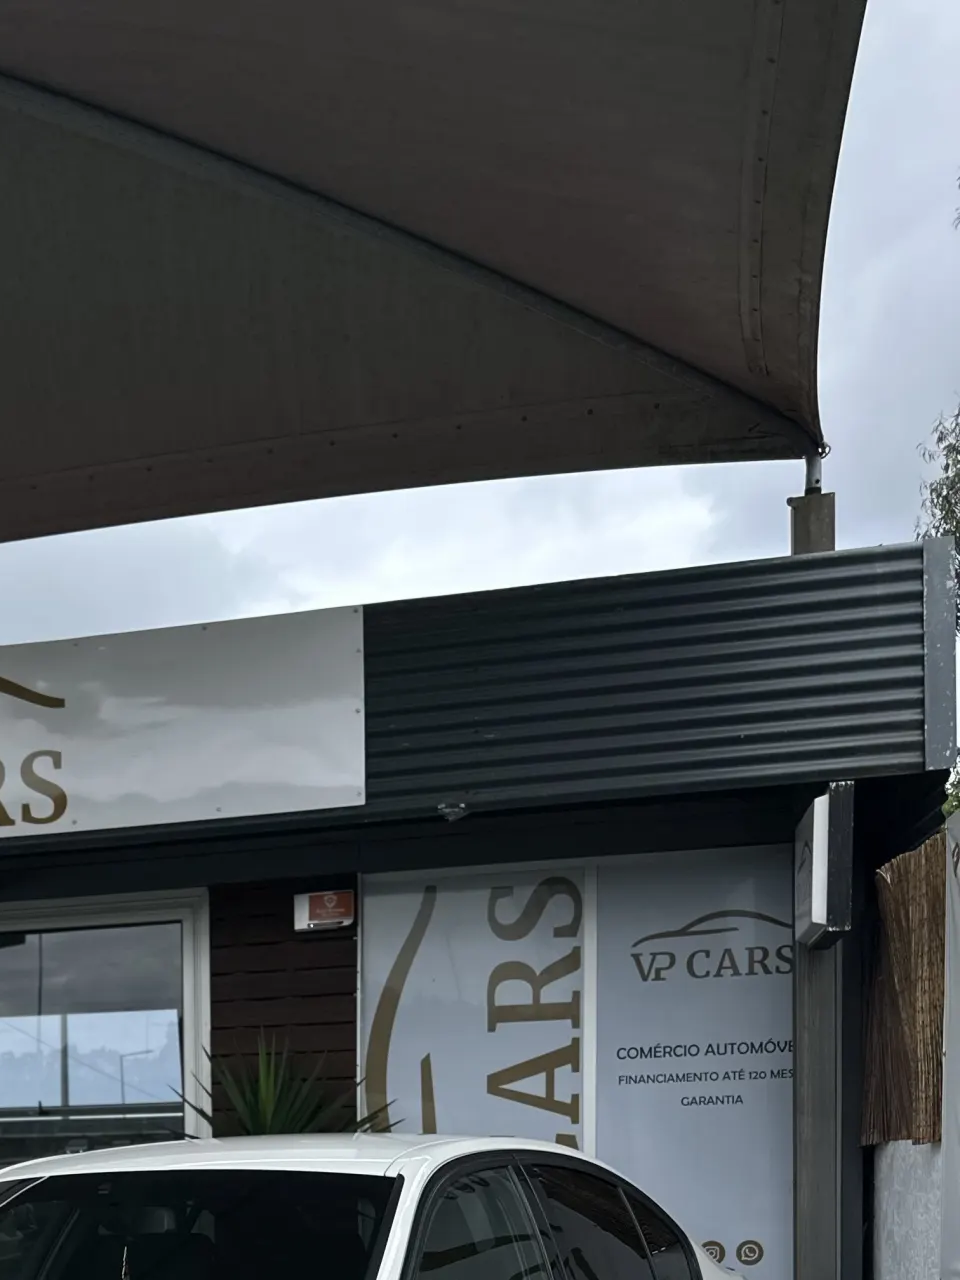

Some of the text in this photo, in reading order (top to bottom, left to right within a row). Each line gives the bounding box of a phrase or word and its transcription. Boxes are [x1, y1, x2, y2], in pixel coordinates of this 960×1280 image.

[630, 945, 794, 982] VP CARS
[486, 876, 583, 1150] ARS
[616, 1043, 700, 1060] COMÉRCIO
[618, 1071, 719, 1085] FINANCIAMENTO
[722, 1068, 744, 1081] ATÉ
[748, 1070, 767, 1080] 120
[681, 1095, 744, 1106] GARANTIA
